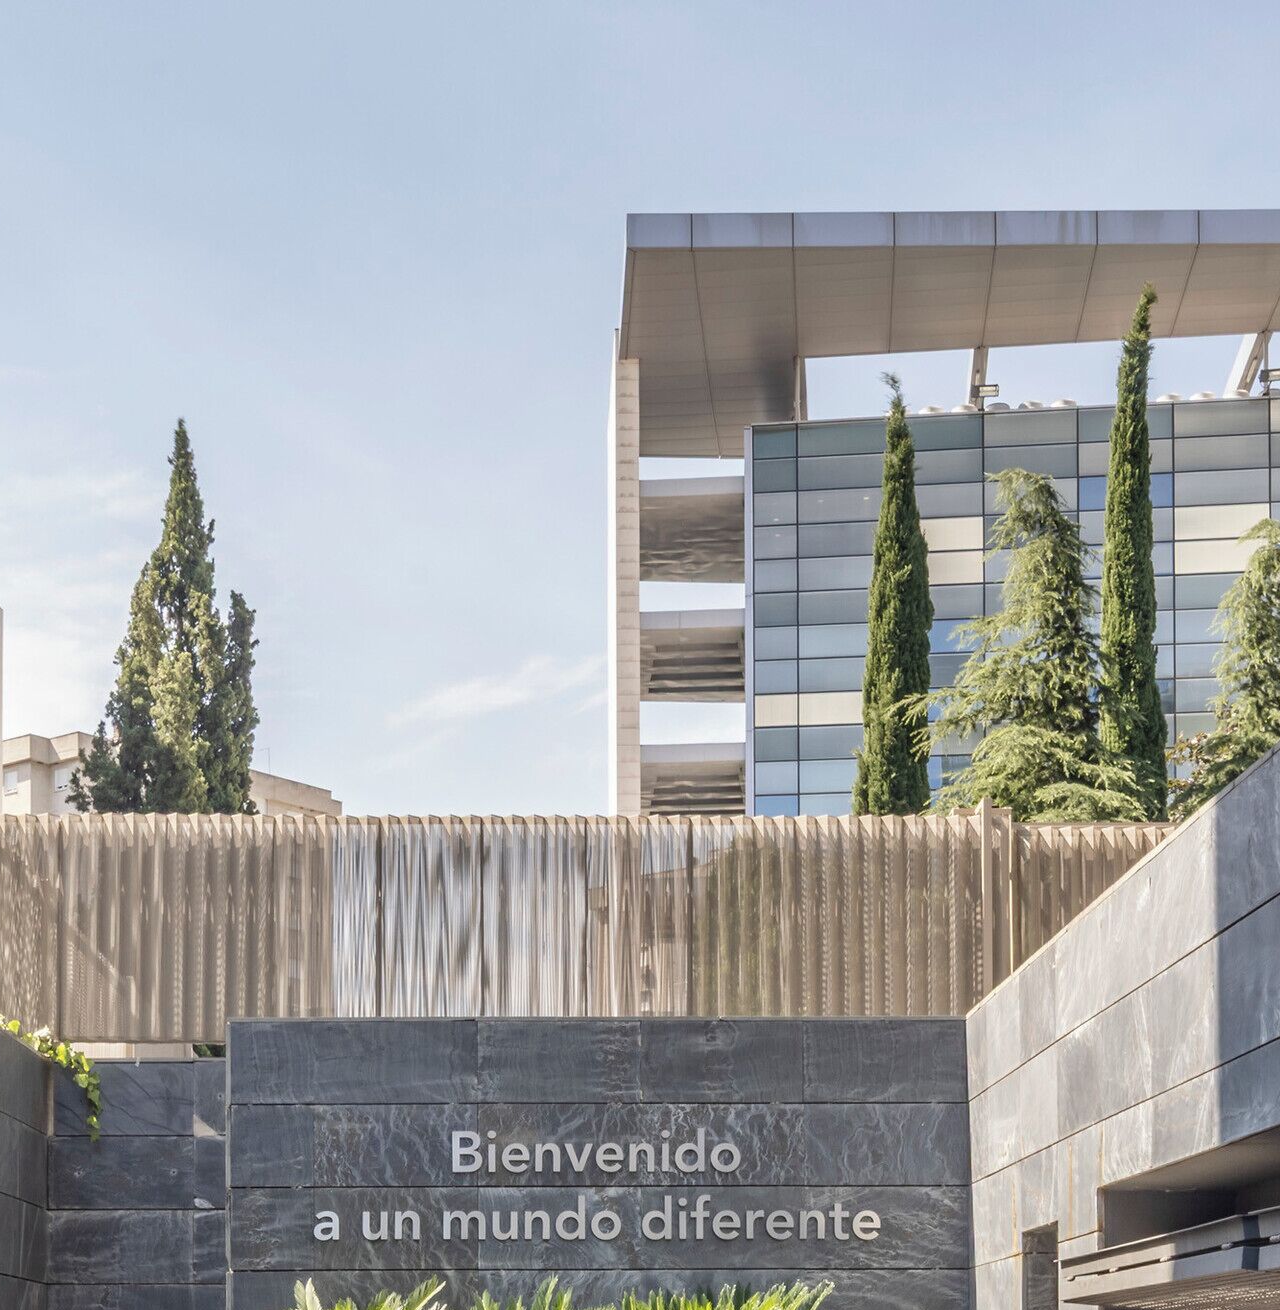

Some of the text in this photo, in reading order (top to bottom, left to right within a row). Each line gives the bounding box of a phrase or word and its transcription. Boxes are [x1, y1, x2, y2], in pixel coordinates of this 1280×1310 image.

[450, 1129, 742, 1174] Bienvenido
[313, 1195, 882, 1241] a un mundo diferente
